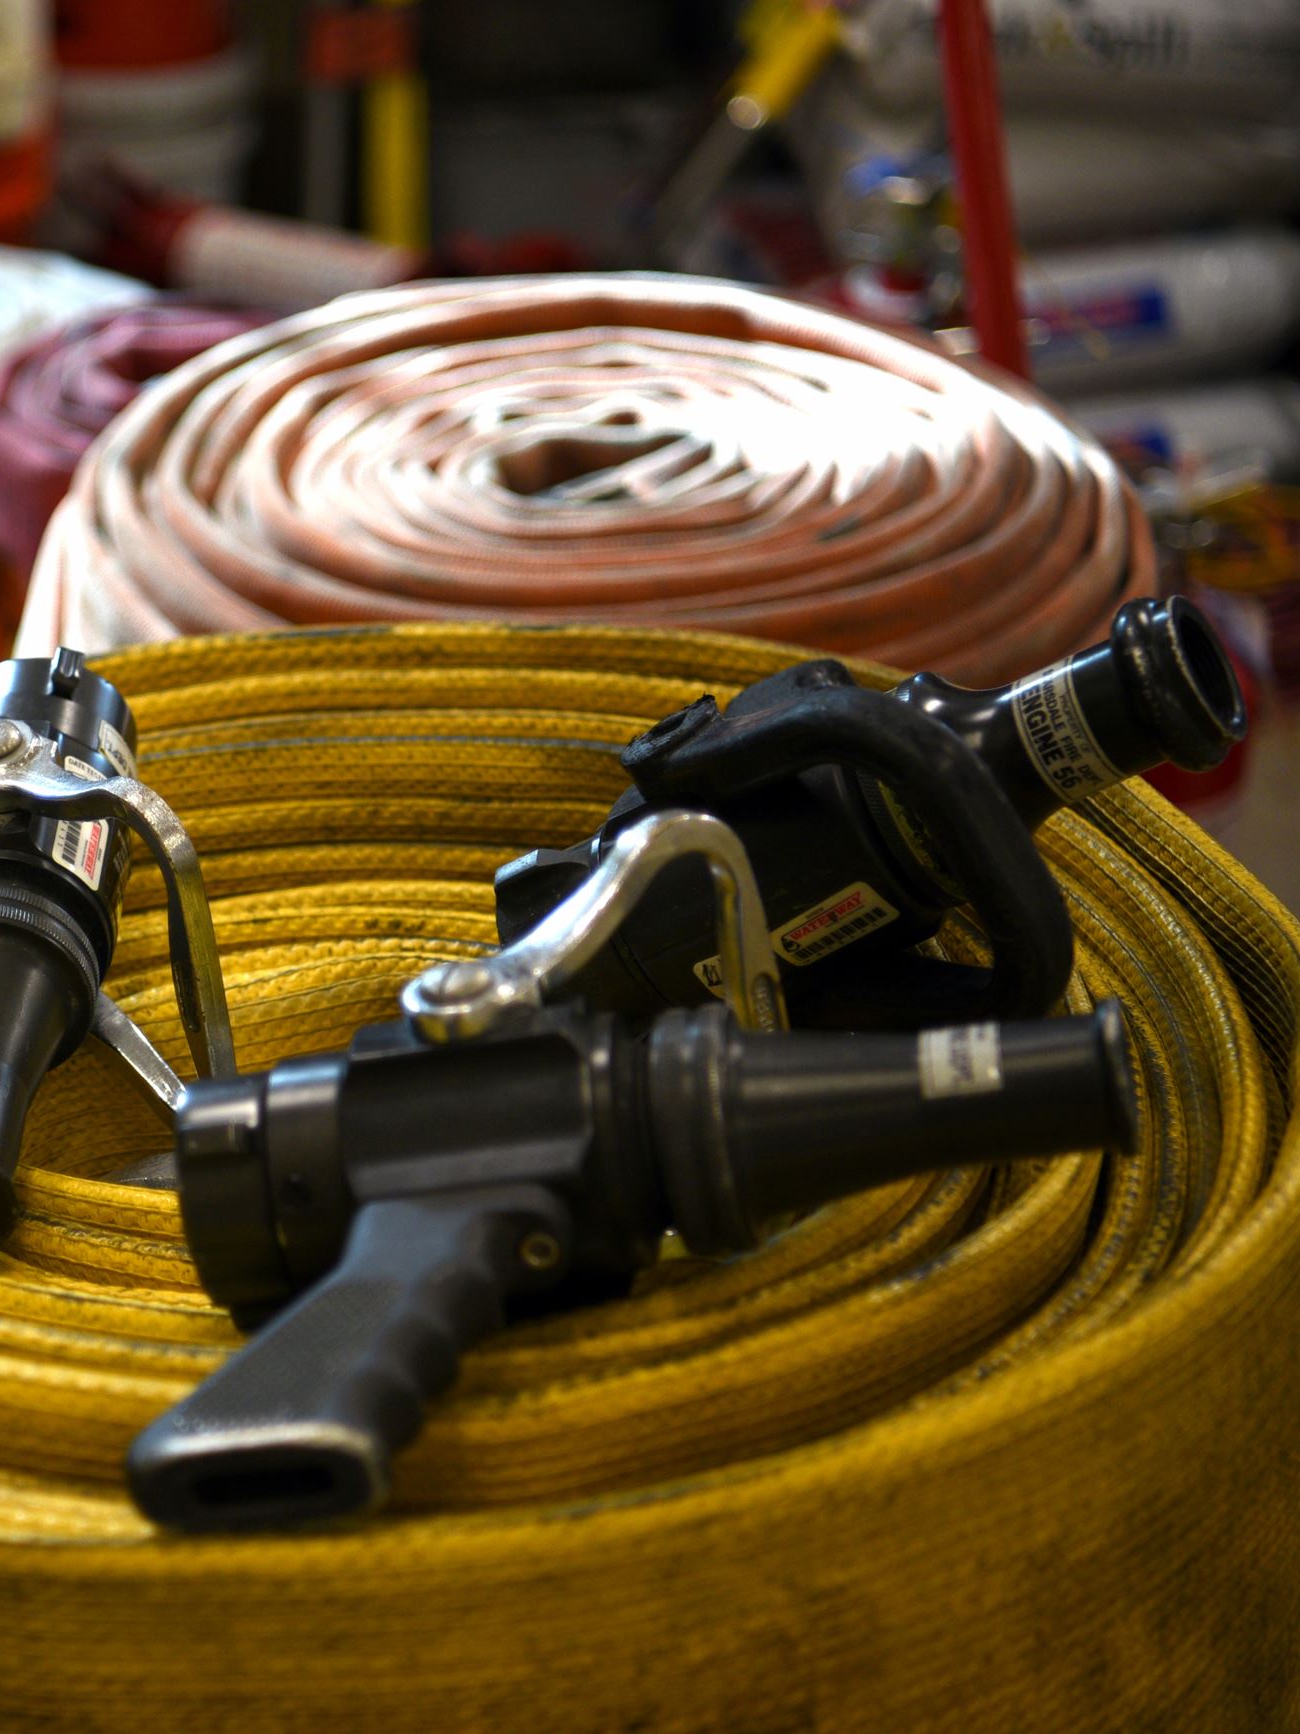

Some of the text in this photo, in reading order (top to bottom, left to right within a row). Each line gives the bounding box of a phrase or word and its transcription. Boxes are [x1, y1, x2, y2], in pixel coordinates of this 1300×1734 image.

[1020, 684, 1084, 790] ENGINE 56
[1042, 668, 1067, 732] SARSDALE
[1058, 735, 1084, 763] FIRE
